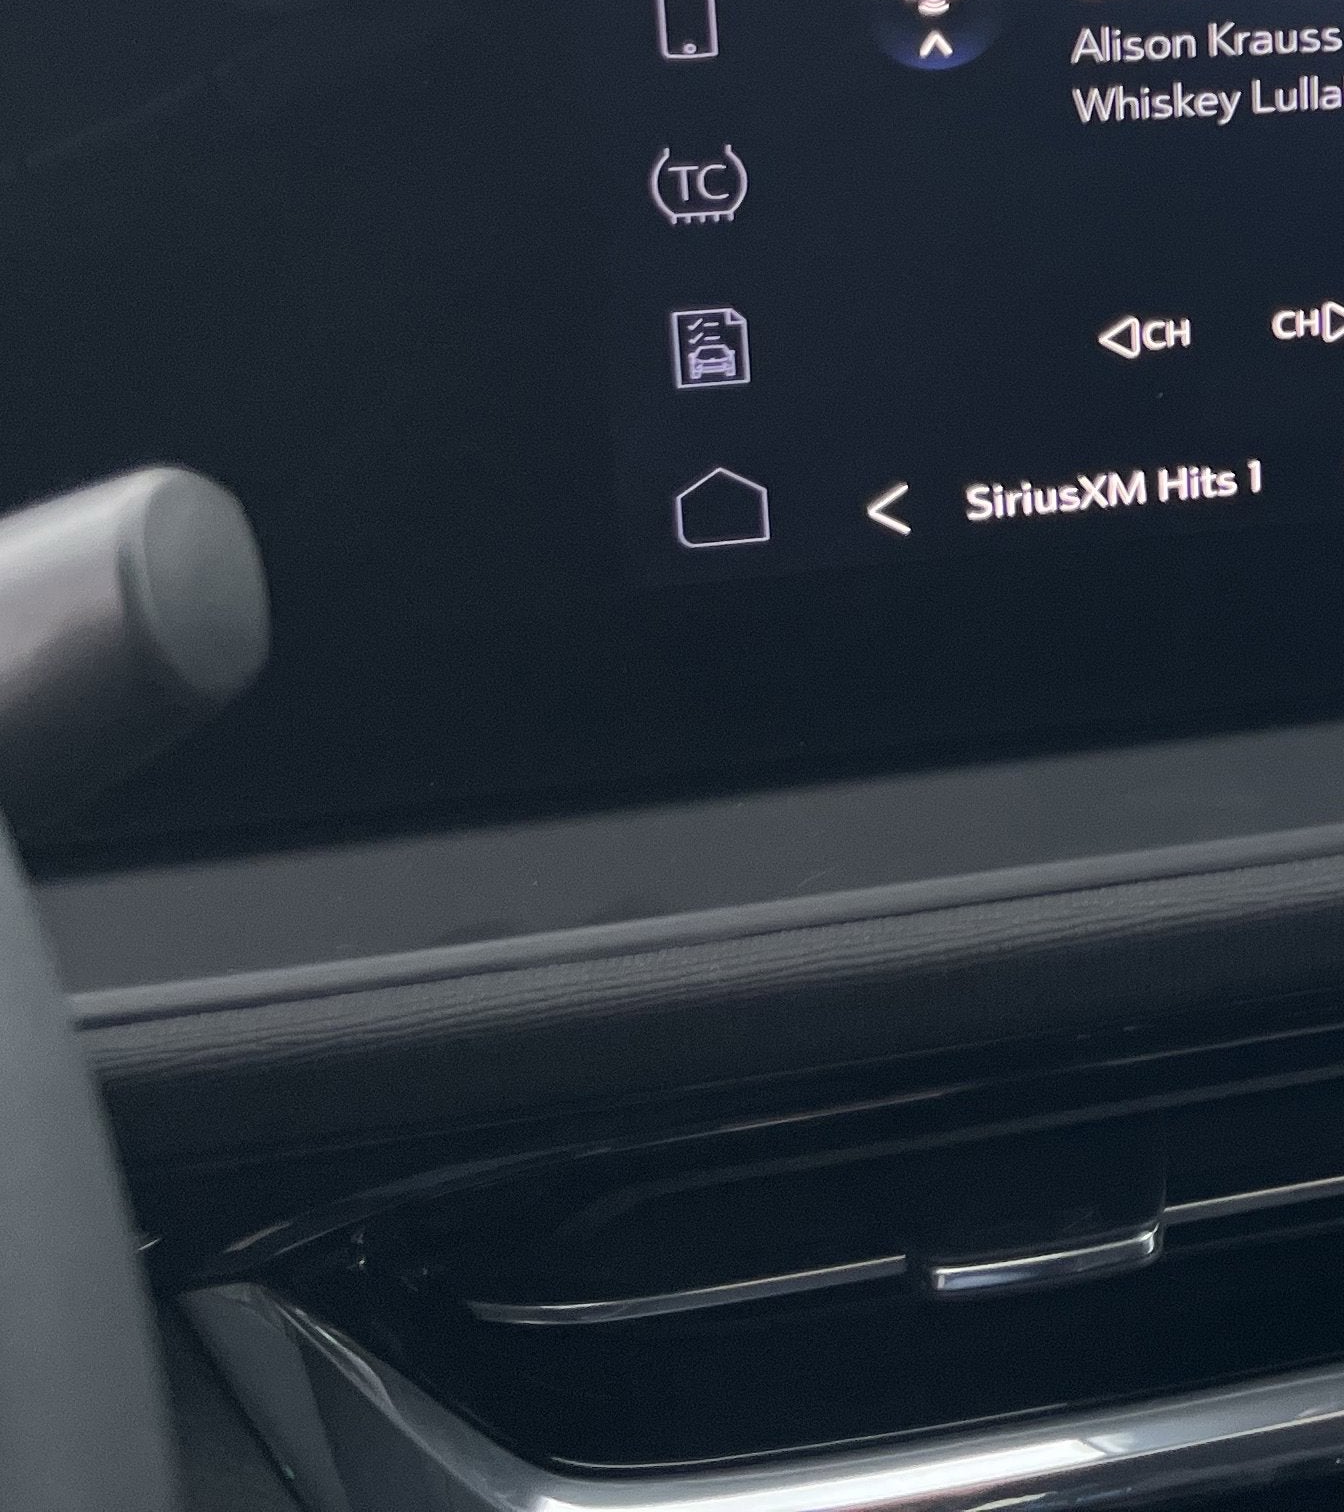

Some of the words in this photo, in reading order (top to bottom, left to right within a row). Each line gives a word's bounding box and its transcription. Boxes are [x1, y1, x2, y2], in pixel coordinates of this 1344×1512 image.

[1070, 26, 1197, 64] Alison
[1208, 21, 1343, 57] Krauss
[1072, 81, 1242, 125] Whiskey
[667, 163, 730, 202] TC
[1142, 318, 1191, 351] CH
[1271, 308, 1321, 340] CH
[965, 470, 1148, 521] SiriusXM
[1157, 466, 1238, 503] Hits
[1247, 459, 1262, 495] 1
